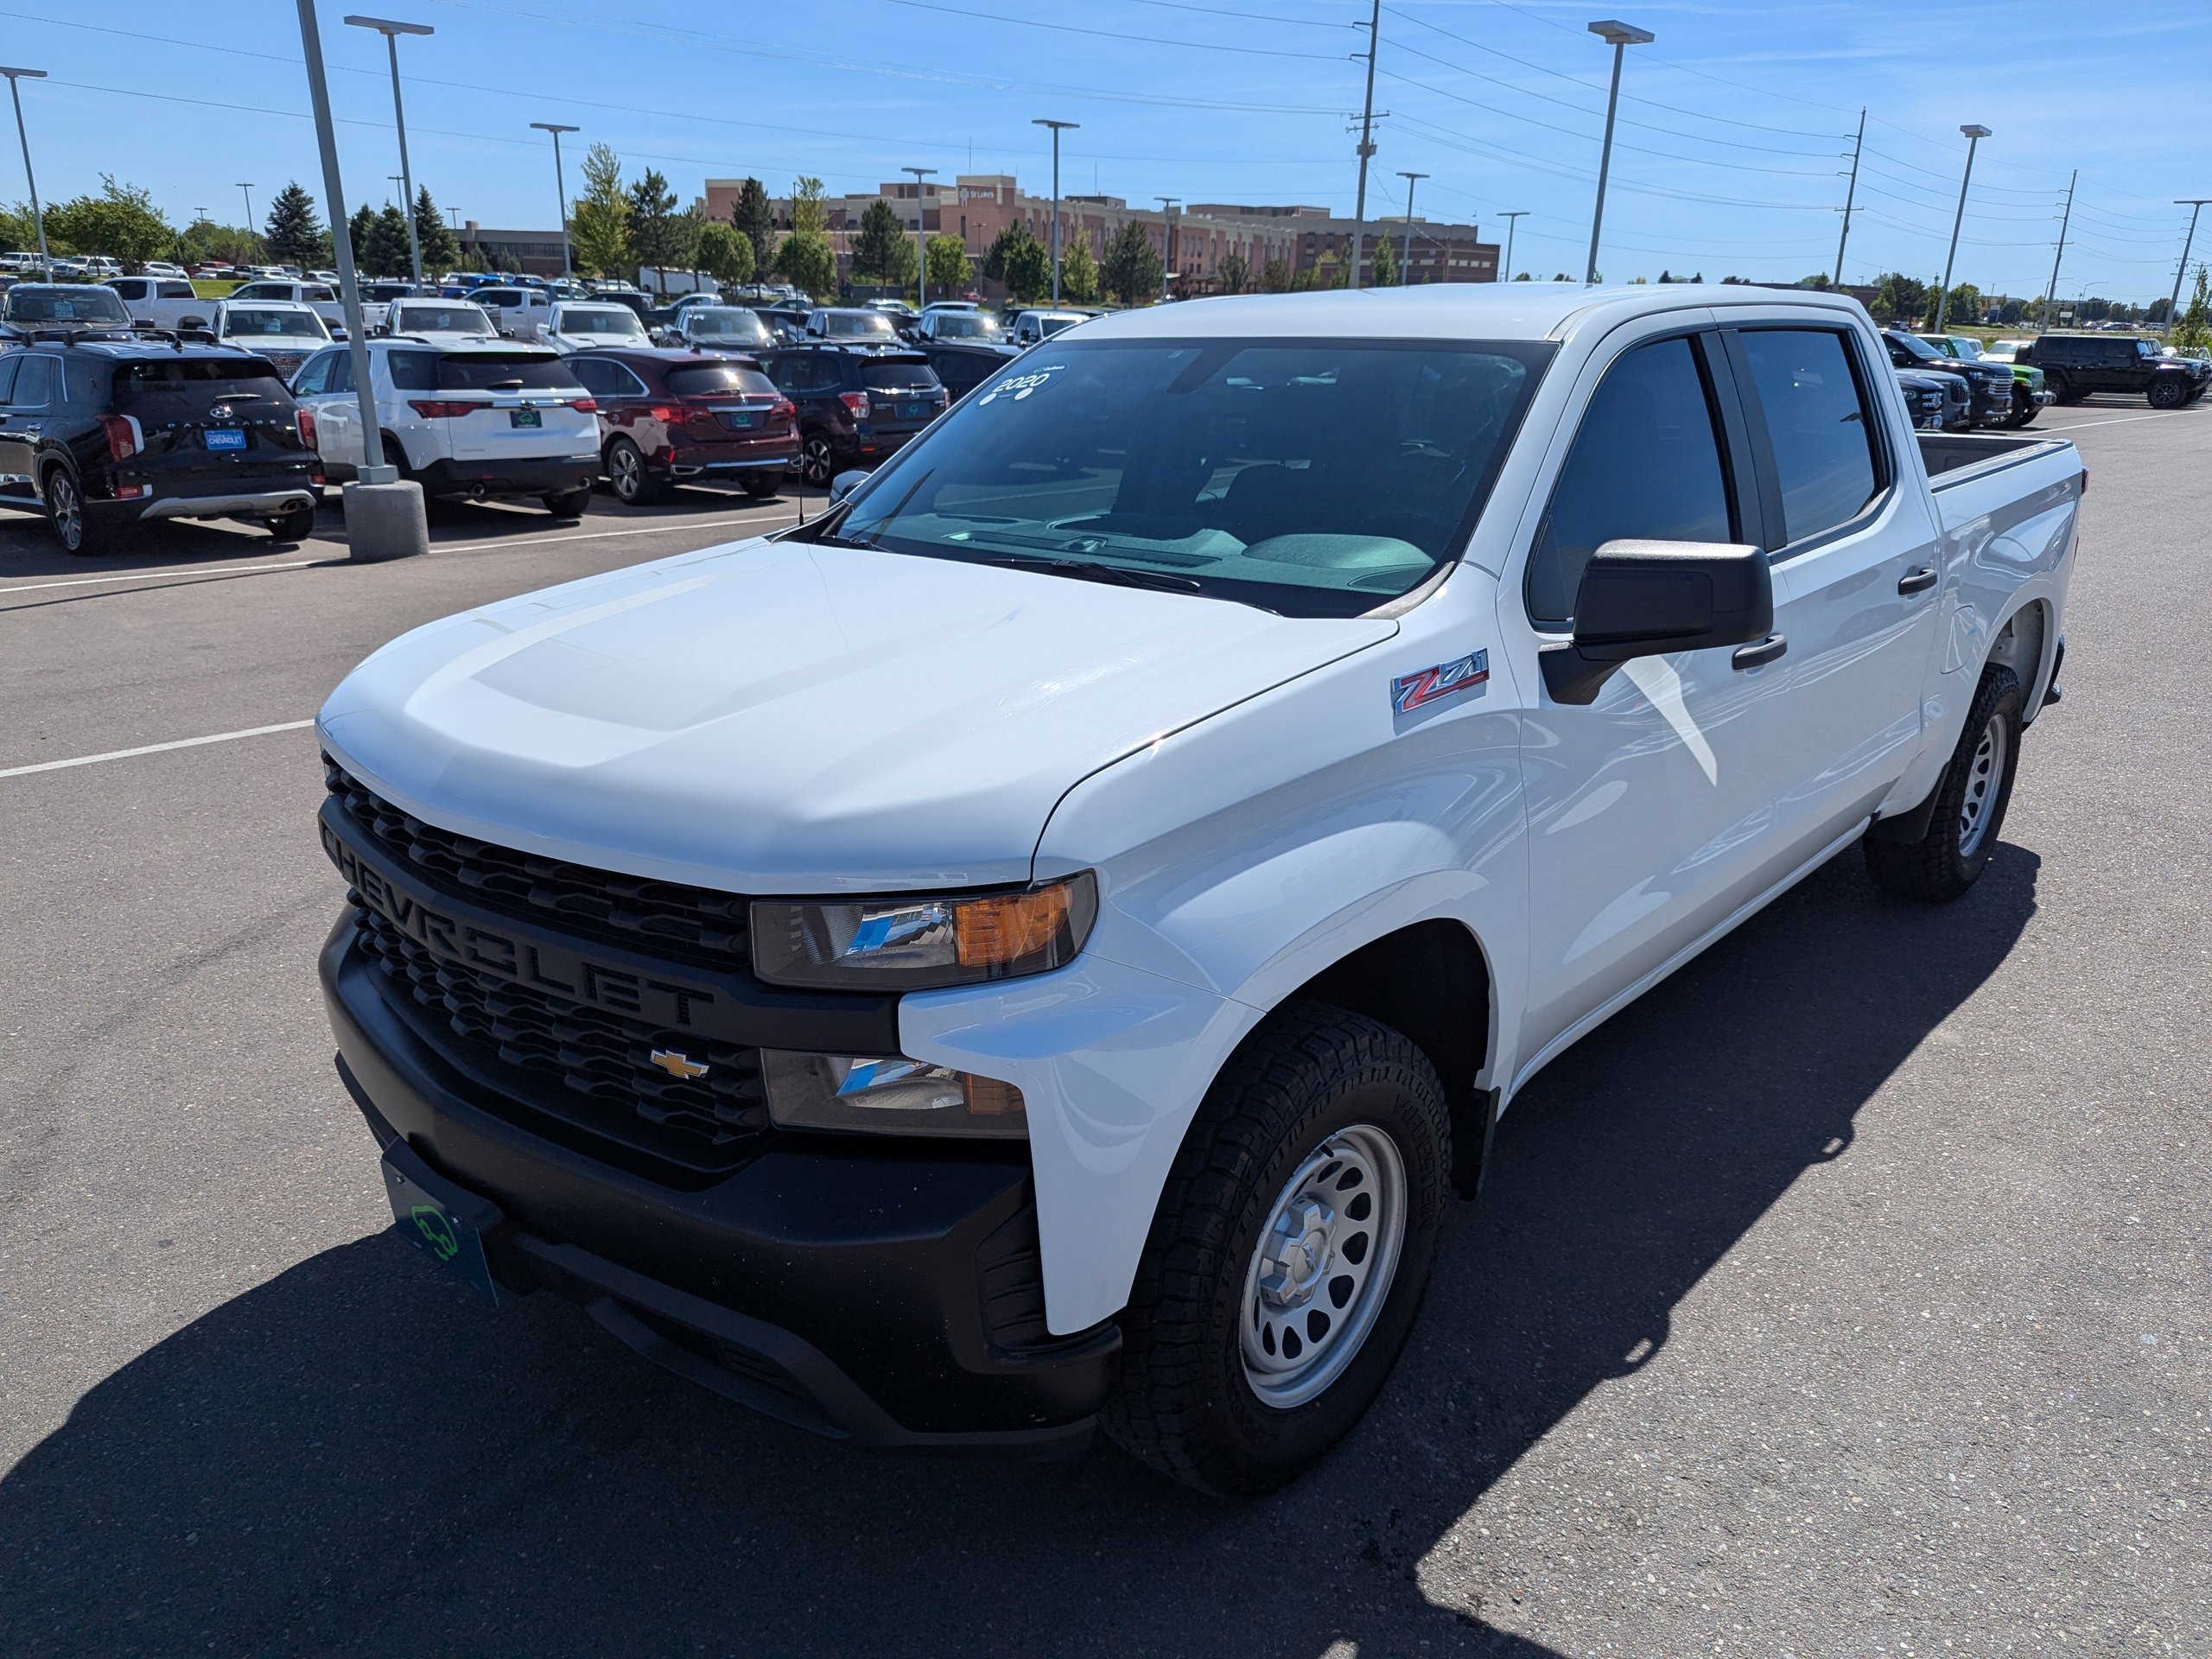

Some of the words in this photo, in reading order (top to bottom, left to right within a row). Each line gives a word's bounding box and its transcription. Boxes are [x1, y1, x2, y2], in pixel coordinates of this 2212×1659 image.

[992, 372, 1051, 393] 2020
[168, 419, 276, 429] PALISADE
[1391, 647, 1490, 715] Z71
[321, 822, 715, 1026] CHEVROLET
